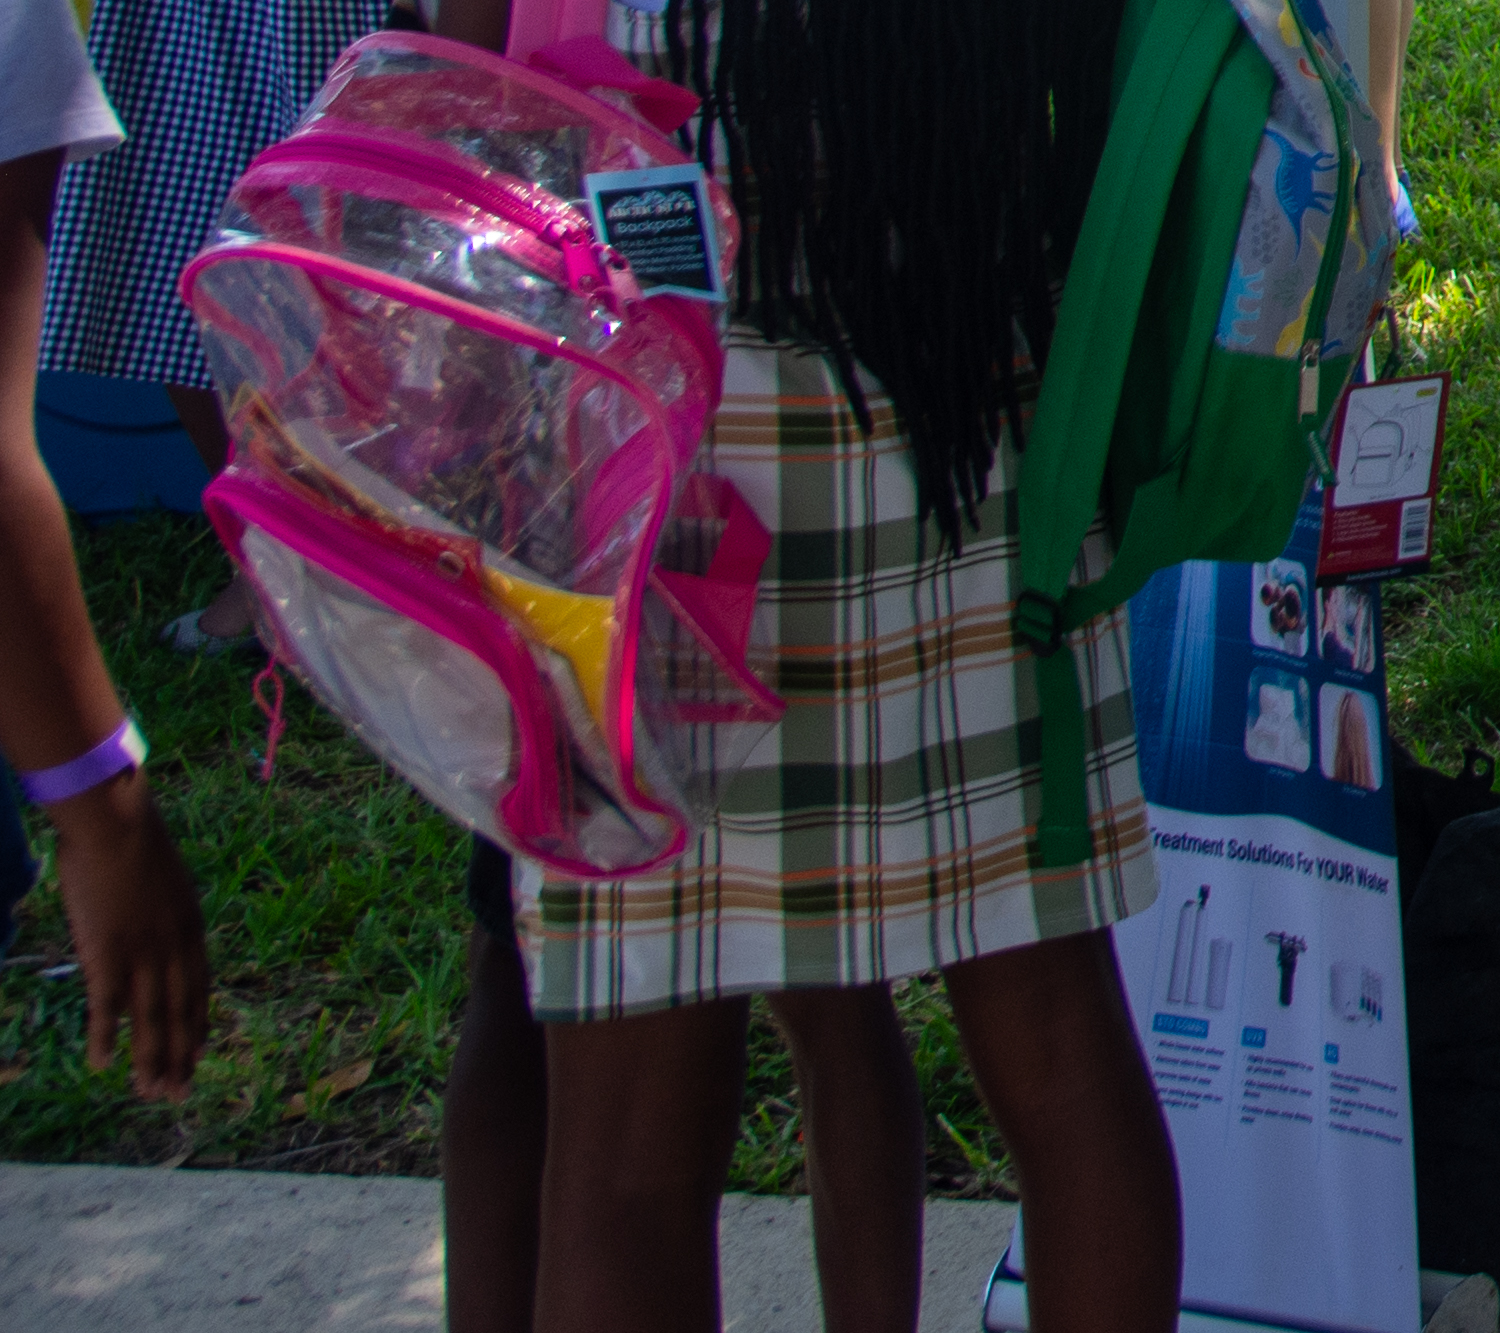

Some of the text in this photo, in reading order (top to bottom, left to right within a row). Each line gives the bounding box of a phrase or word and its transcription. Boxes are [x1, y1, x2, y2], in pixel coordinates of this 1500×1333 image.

[615, 215, 694, 236] Backpack
[1227, 838, 1295, 870] Solutions
[1297, 851, 1314, 874] For
[1316, 856, 1354, 885] YOUR
[1356, 865, 1389, 894] Water
